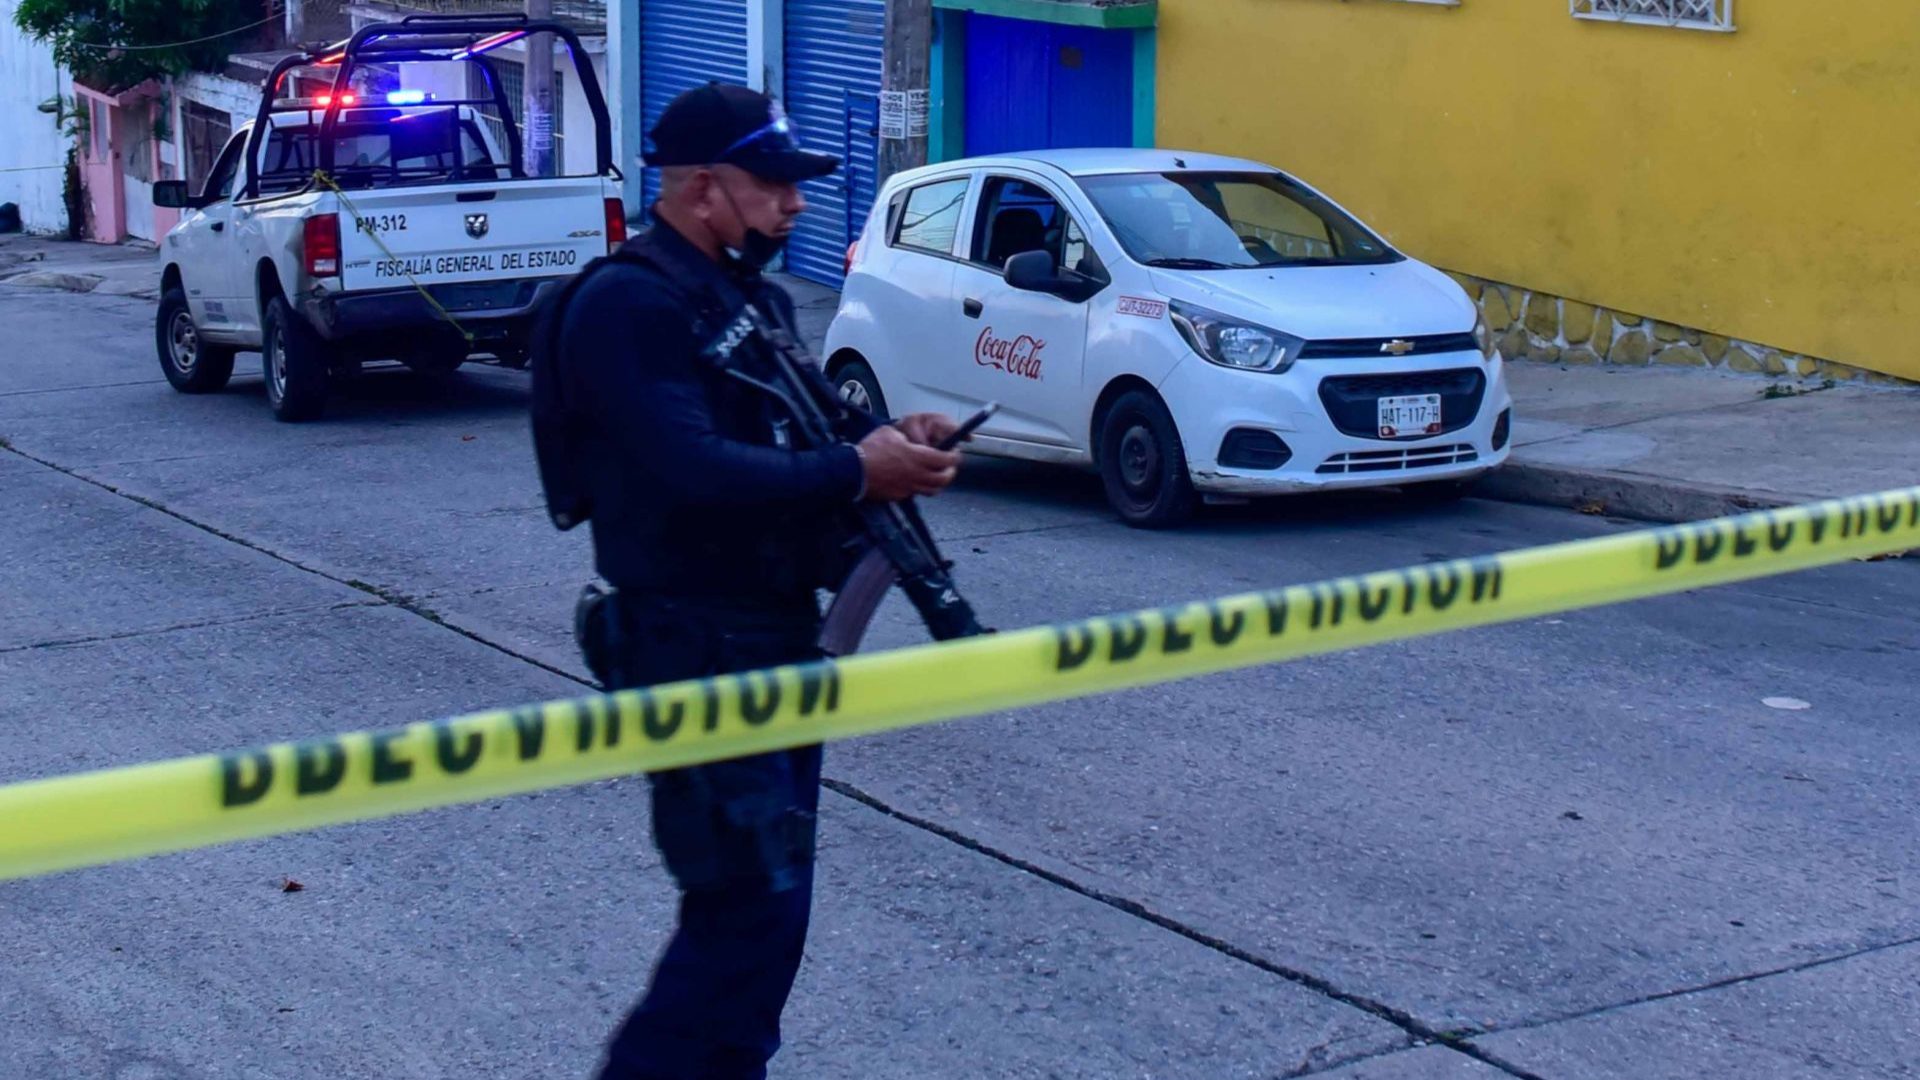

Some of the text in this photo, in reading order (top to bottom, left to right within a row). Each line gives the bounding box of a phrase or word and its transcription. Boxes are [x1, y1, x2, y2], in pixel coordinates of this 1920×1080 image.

[356, 214, 407, 233] PM-312
[436, 254, 494, 274] GENERAL
[501, 252, 525, 269] DEL
[528, 250, 577, 267] ESTADO
[1381, 406, 1438, 424] HAT-117-H
